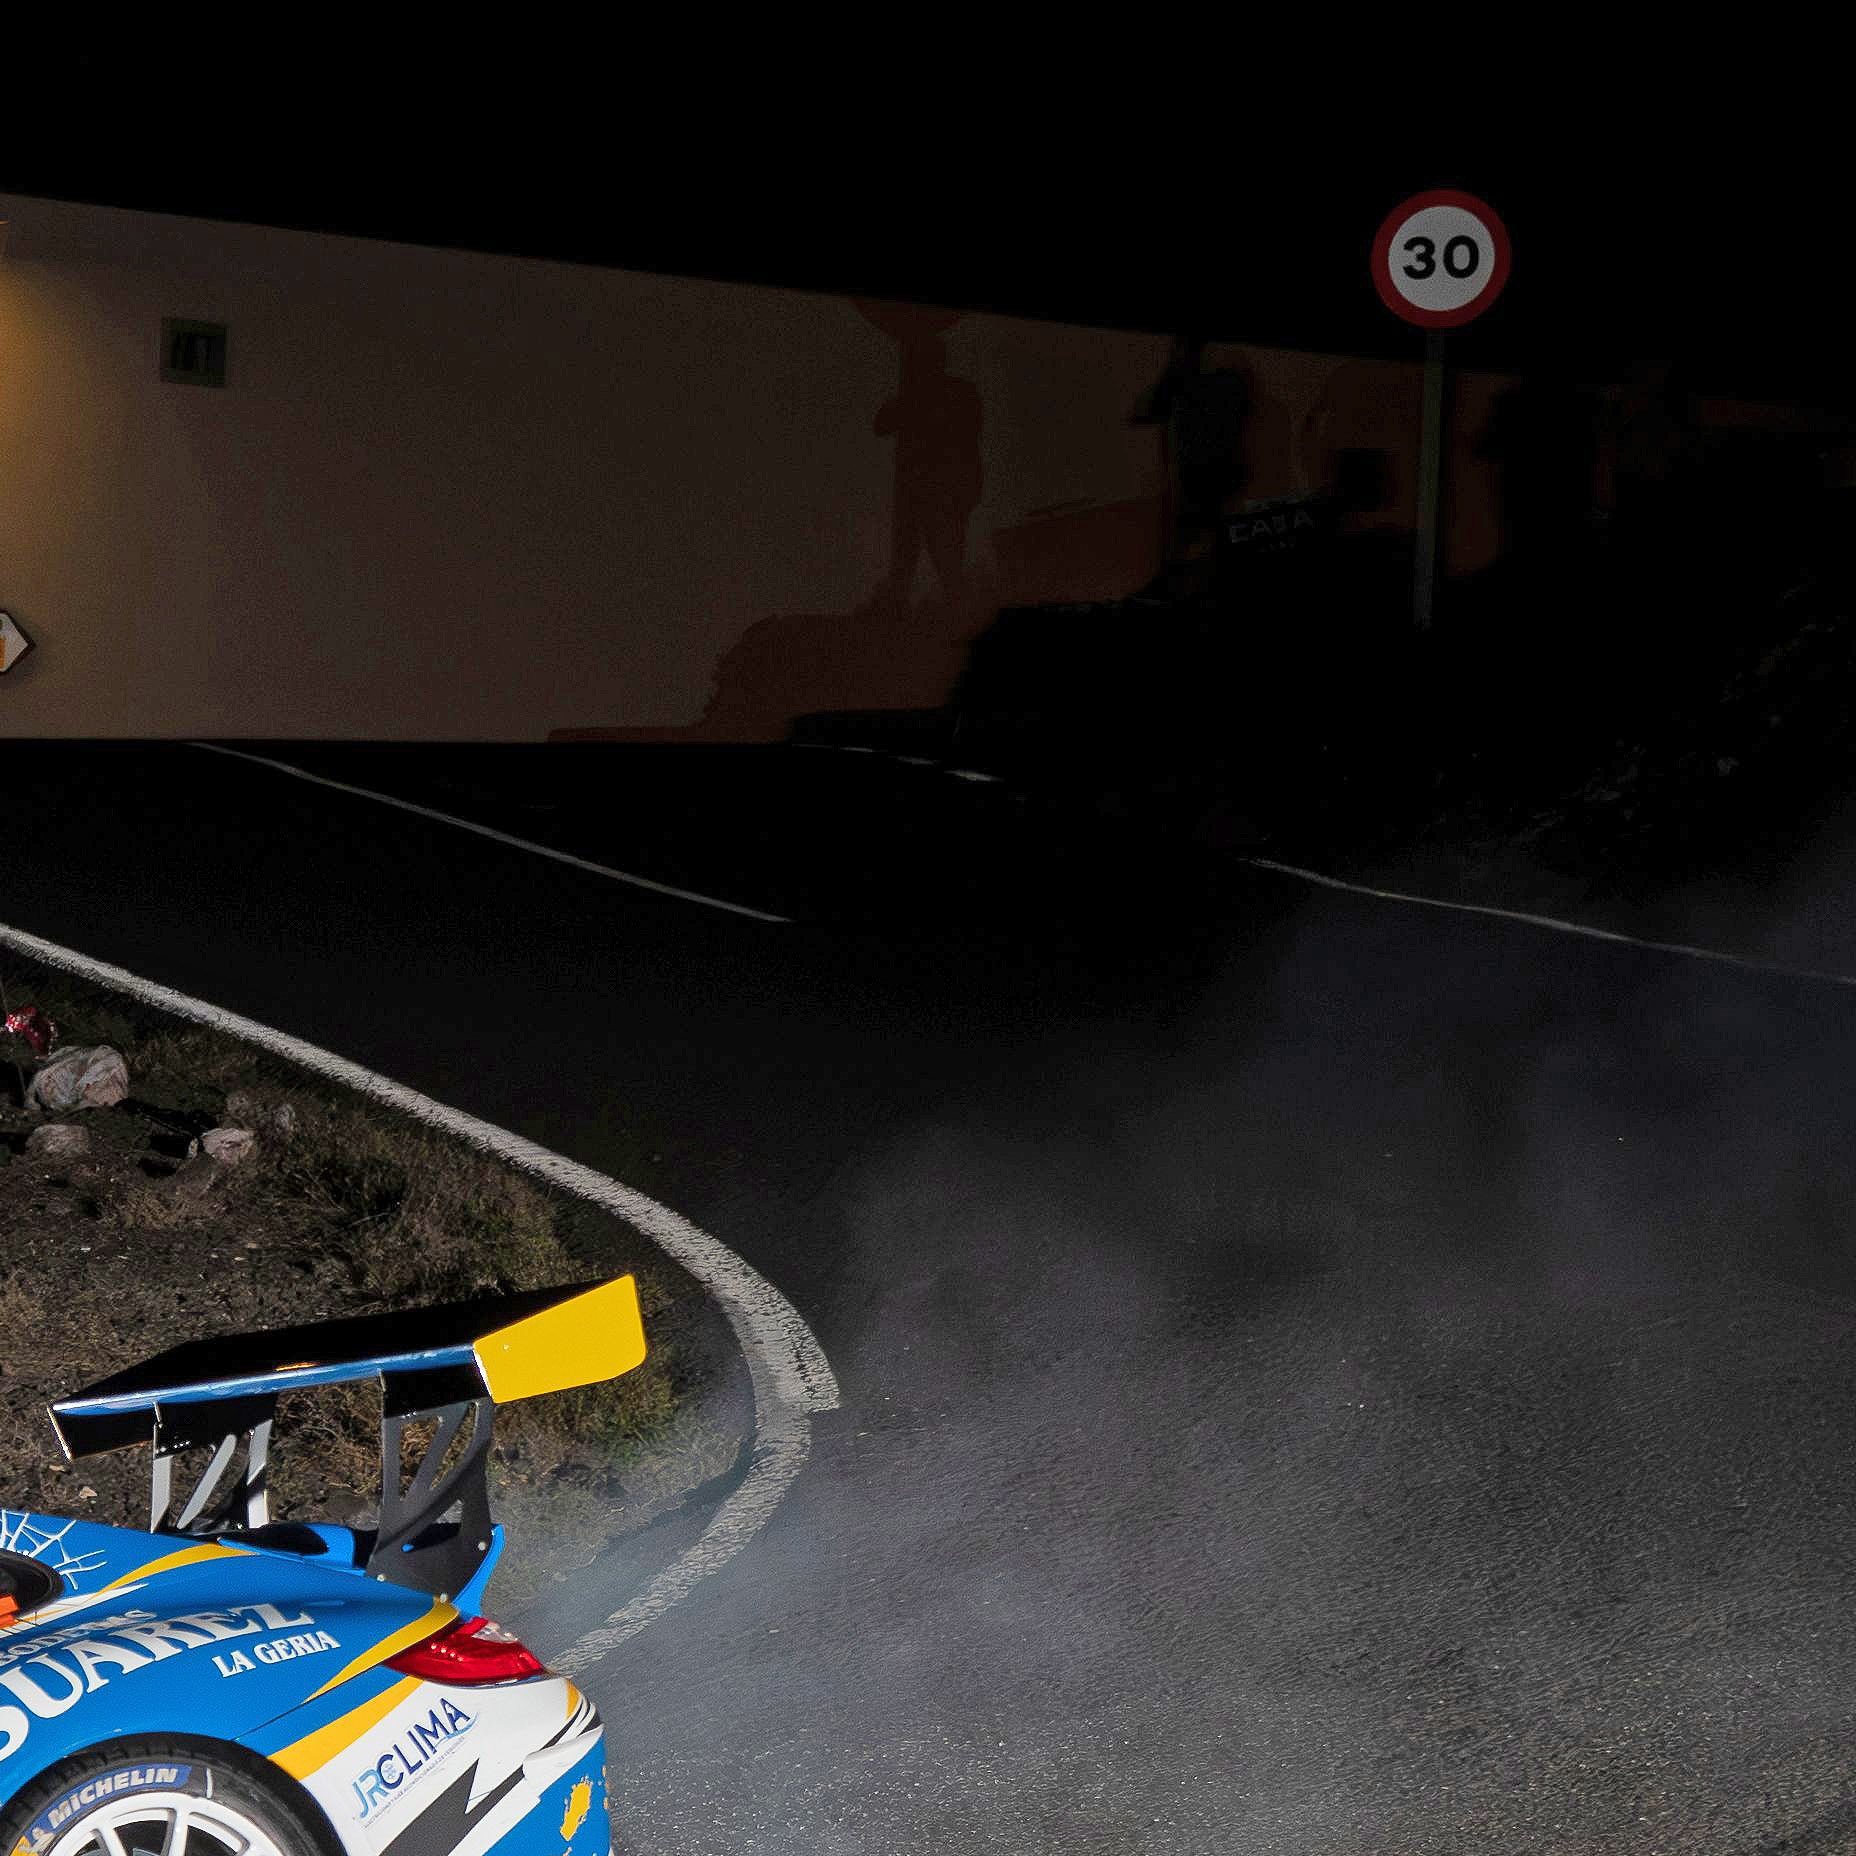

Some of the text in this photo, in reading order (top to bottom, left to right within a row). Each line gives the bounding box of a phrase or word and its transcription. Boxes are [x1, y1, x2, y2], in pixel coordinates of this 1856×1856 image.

[1403, 235, 1479, 280] 30
[211, 1631, 341, 1677] LA GERIA
[47, 1767, 179, 1829] MICHELIN
